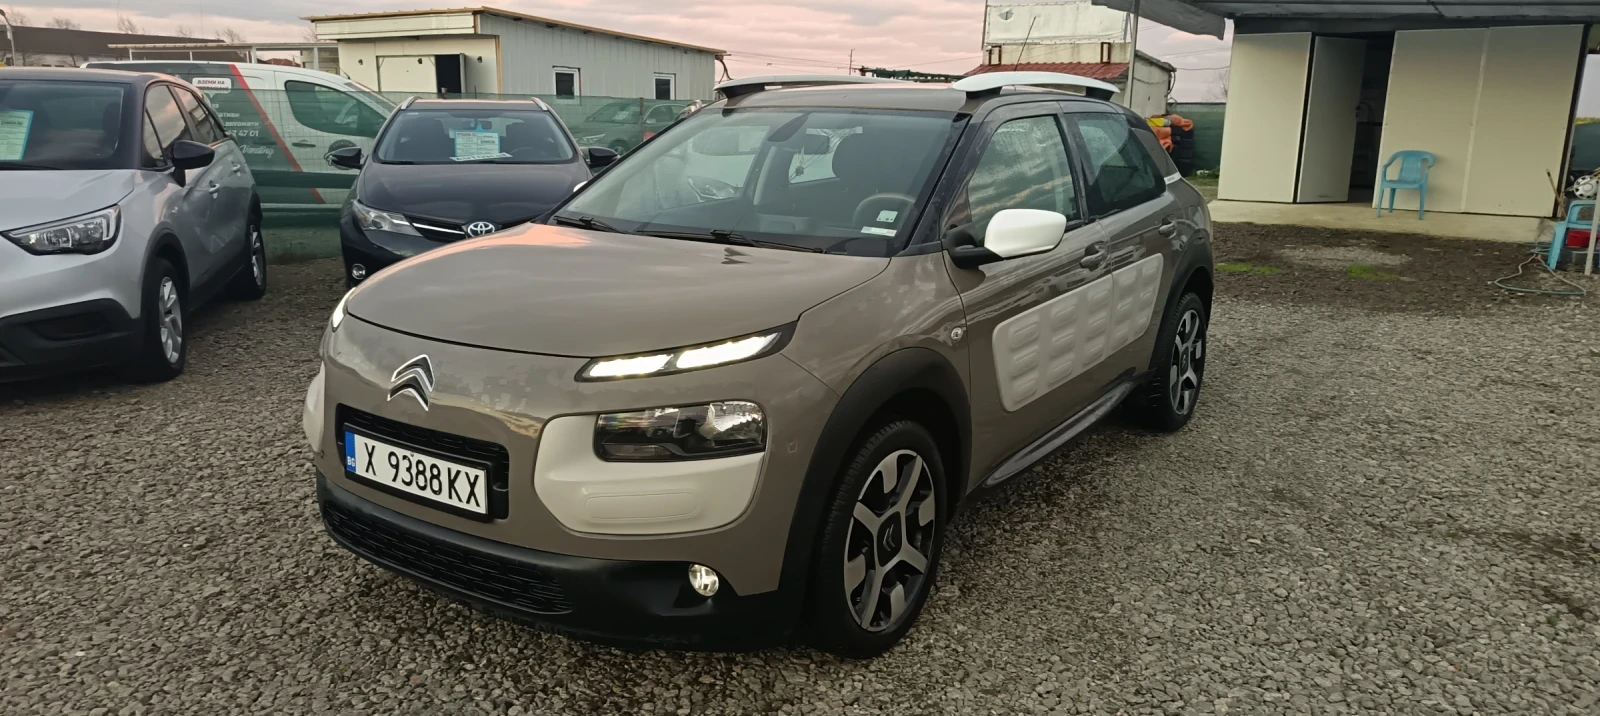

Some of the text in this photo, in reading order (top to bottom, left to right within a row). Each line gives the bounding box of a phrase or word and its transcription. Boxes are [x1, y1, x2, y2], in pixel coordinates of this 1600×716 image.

[239, 144, 275, 159] Vending
[346, 455, 356, 467] BG
[364, 442, 377, 476] X
